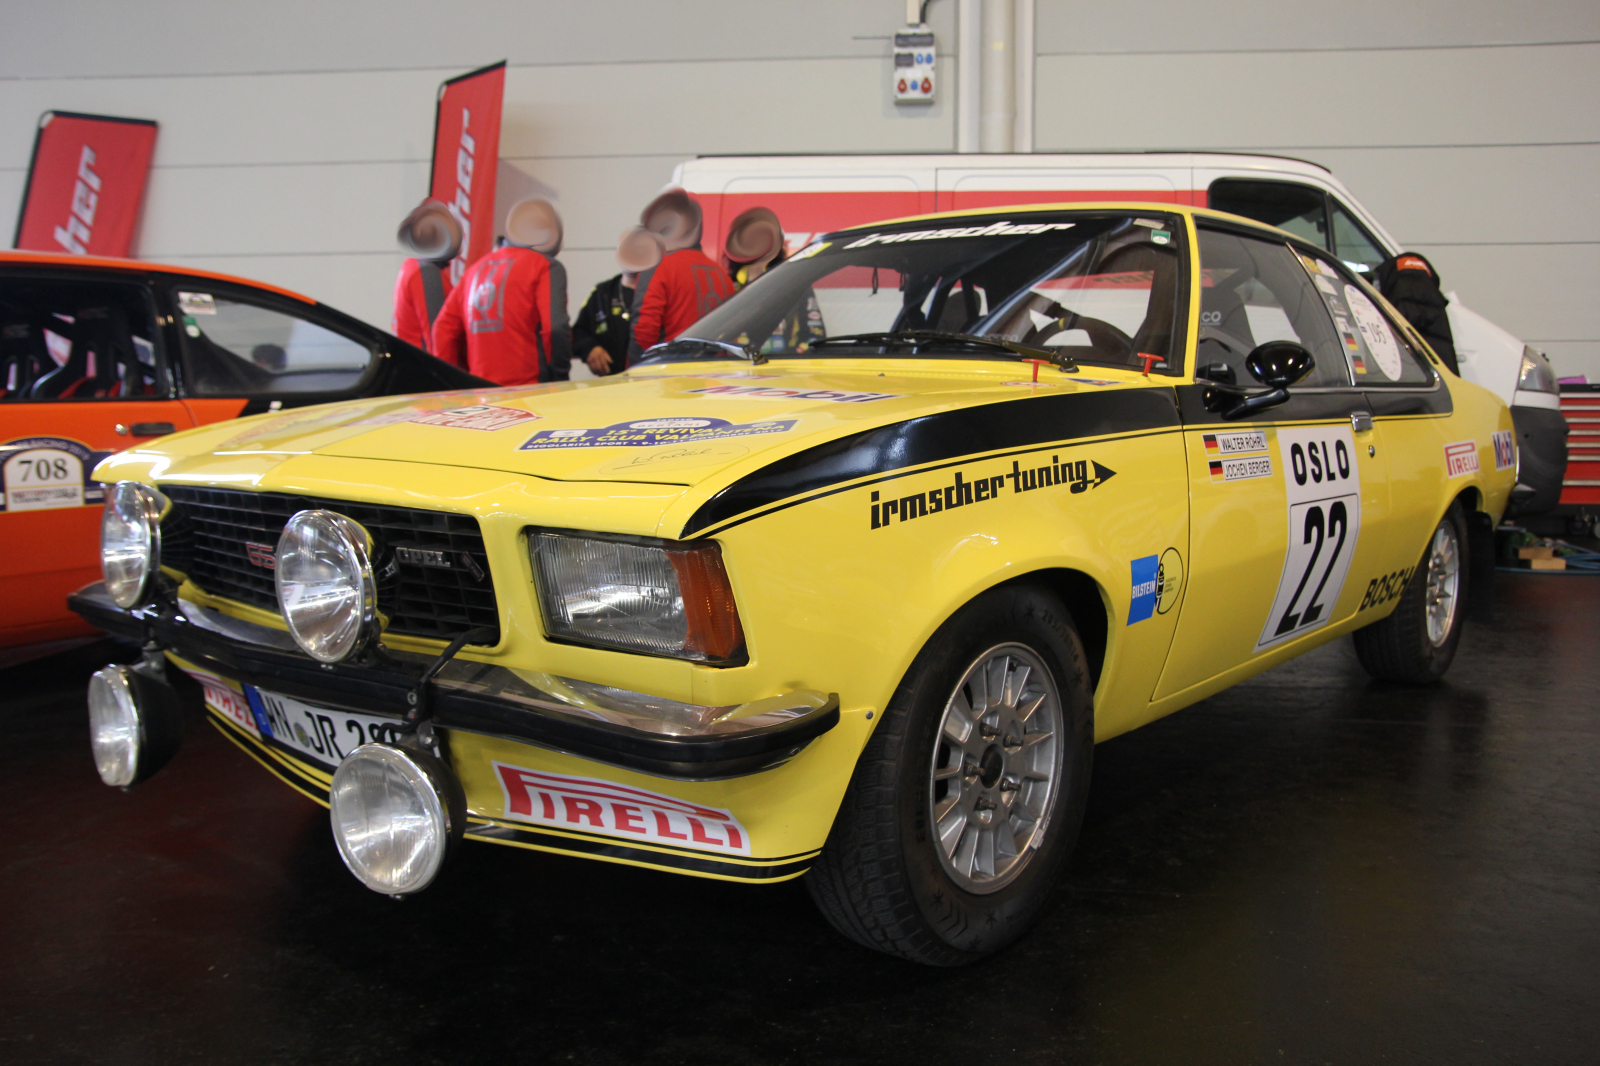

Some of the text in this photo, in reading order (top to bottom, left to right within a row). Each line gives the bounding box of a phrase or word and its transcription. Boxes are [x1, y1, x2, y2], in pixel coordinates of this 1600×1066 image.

[842, 222, 1076, 249] irmscher
[687, 385, 896, 402] Mobil
[531, 425, 785, 444] RALLY CLUB VALPANTENA
[1220, 433, 1265, 450] WALTER RÖHRL
[1291, 439, 1350, 486] OSLO
[1444, 442, 1479, 476] PIRELLI
[1492, 431, 1515, 469] Mobil
[18, 458, 68, 482] 708
[1225, 460, 1271, 477] JOCHEN BERGER
[396, 547, 451, 568] OPEL
[1274, 501, 1348, 637] 22
[1132, 580, 1156, 599] BILSTEIN
[1358, 565, 1415, 612] BOSCH
[258, 692, 295, 742] HN
[304, 711, 345, 760] JR
[497, 765, 743, 849] PIRELLI
